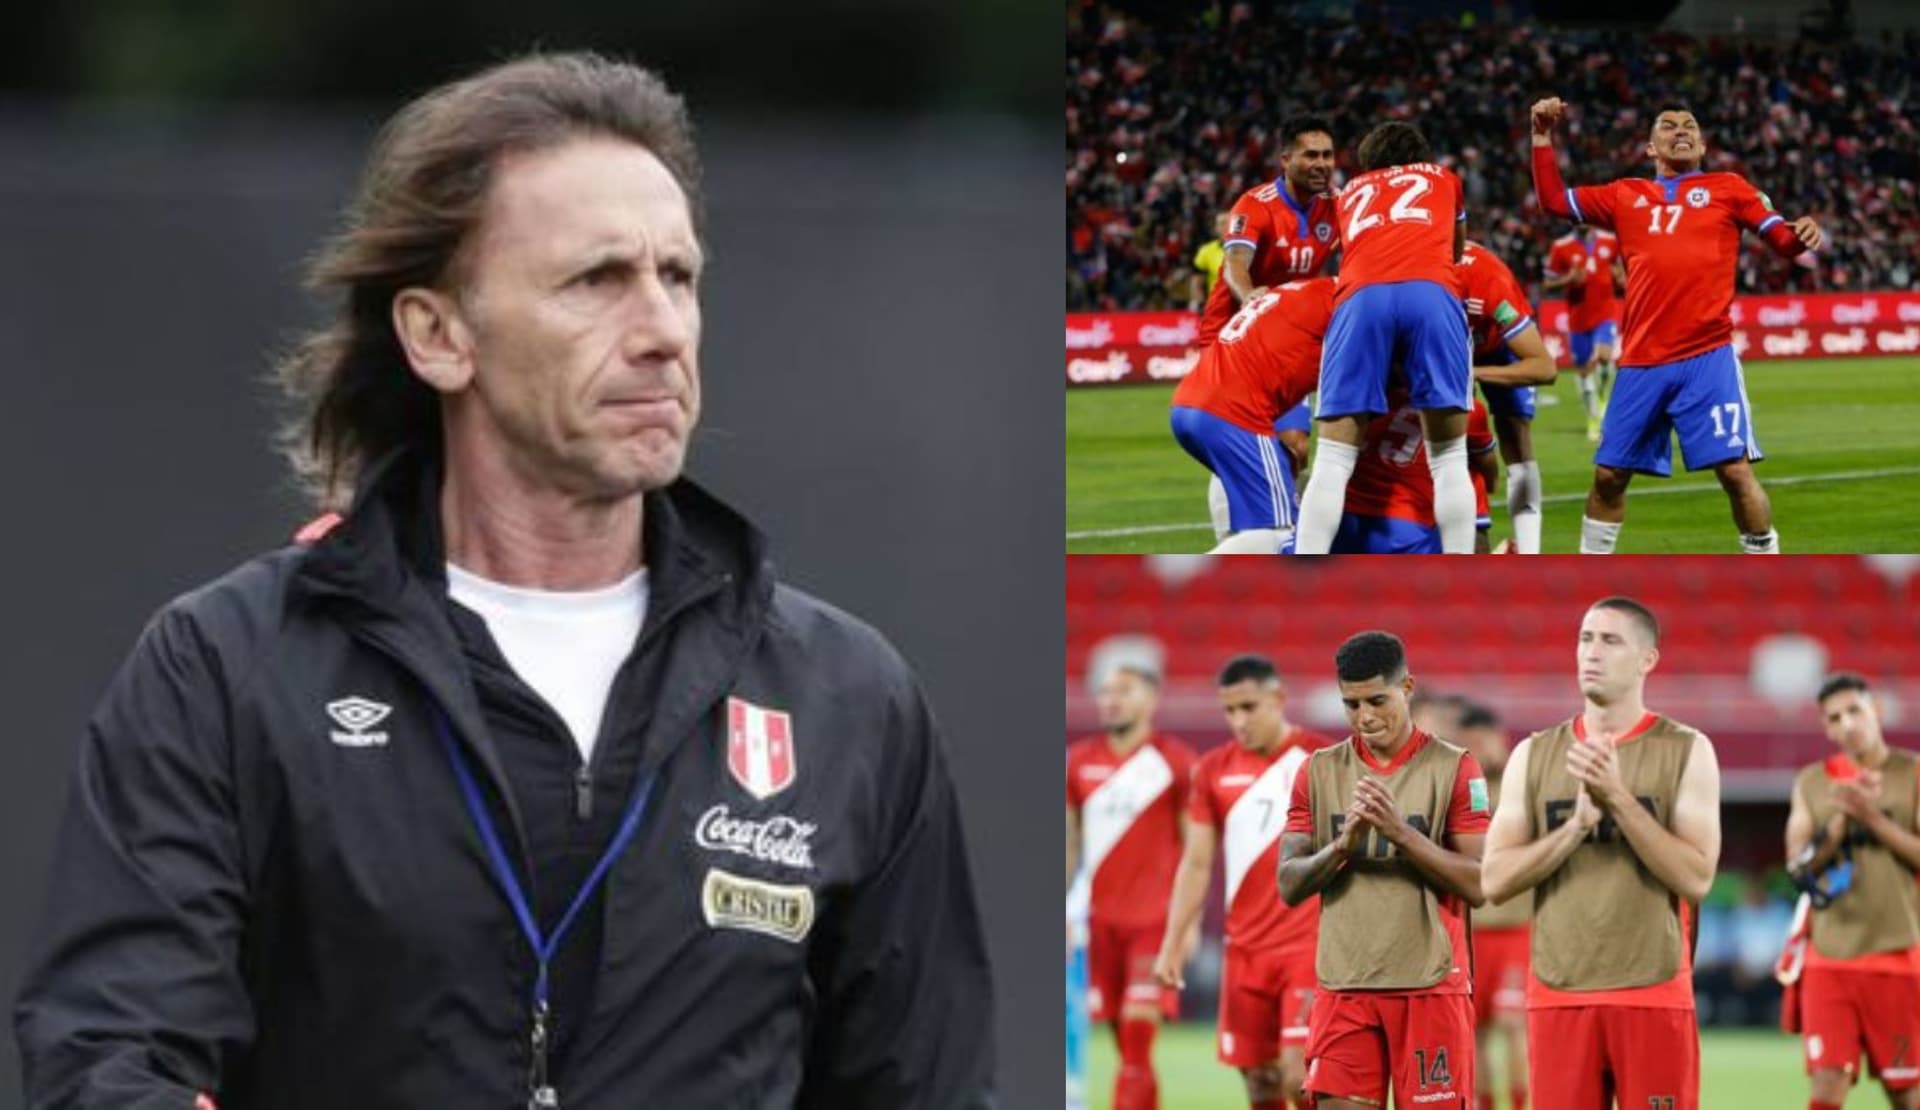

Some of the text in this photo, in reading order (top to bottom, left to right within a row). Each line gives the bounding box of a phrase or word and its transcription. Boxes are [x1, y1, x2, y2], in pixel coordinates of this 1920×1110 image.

[1343, 173, 1433, 242] 22
[1647, 204, 1684, 235] 17
[1288, 245, 1314, 274] 10
[1218, 292, 1282, 345] 8
[1709, 402, 1741, 439] 17
[1256, 797, 1275, 834] 7
[1413, 1046, 1453, 1091] 14
